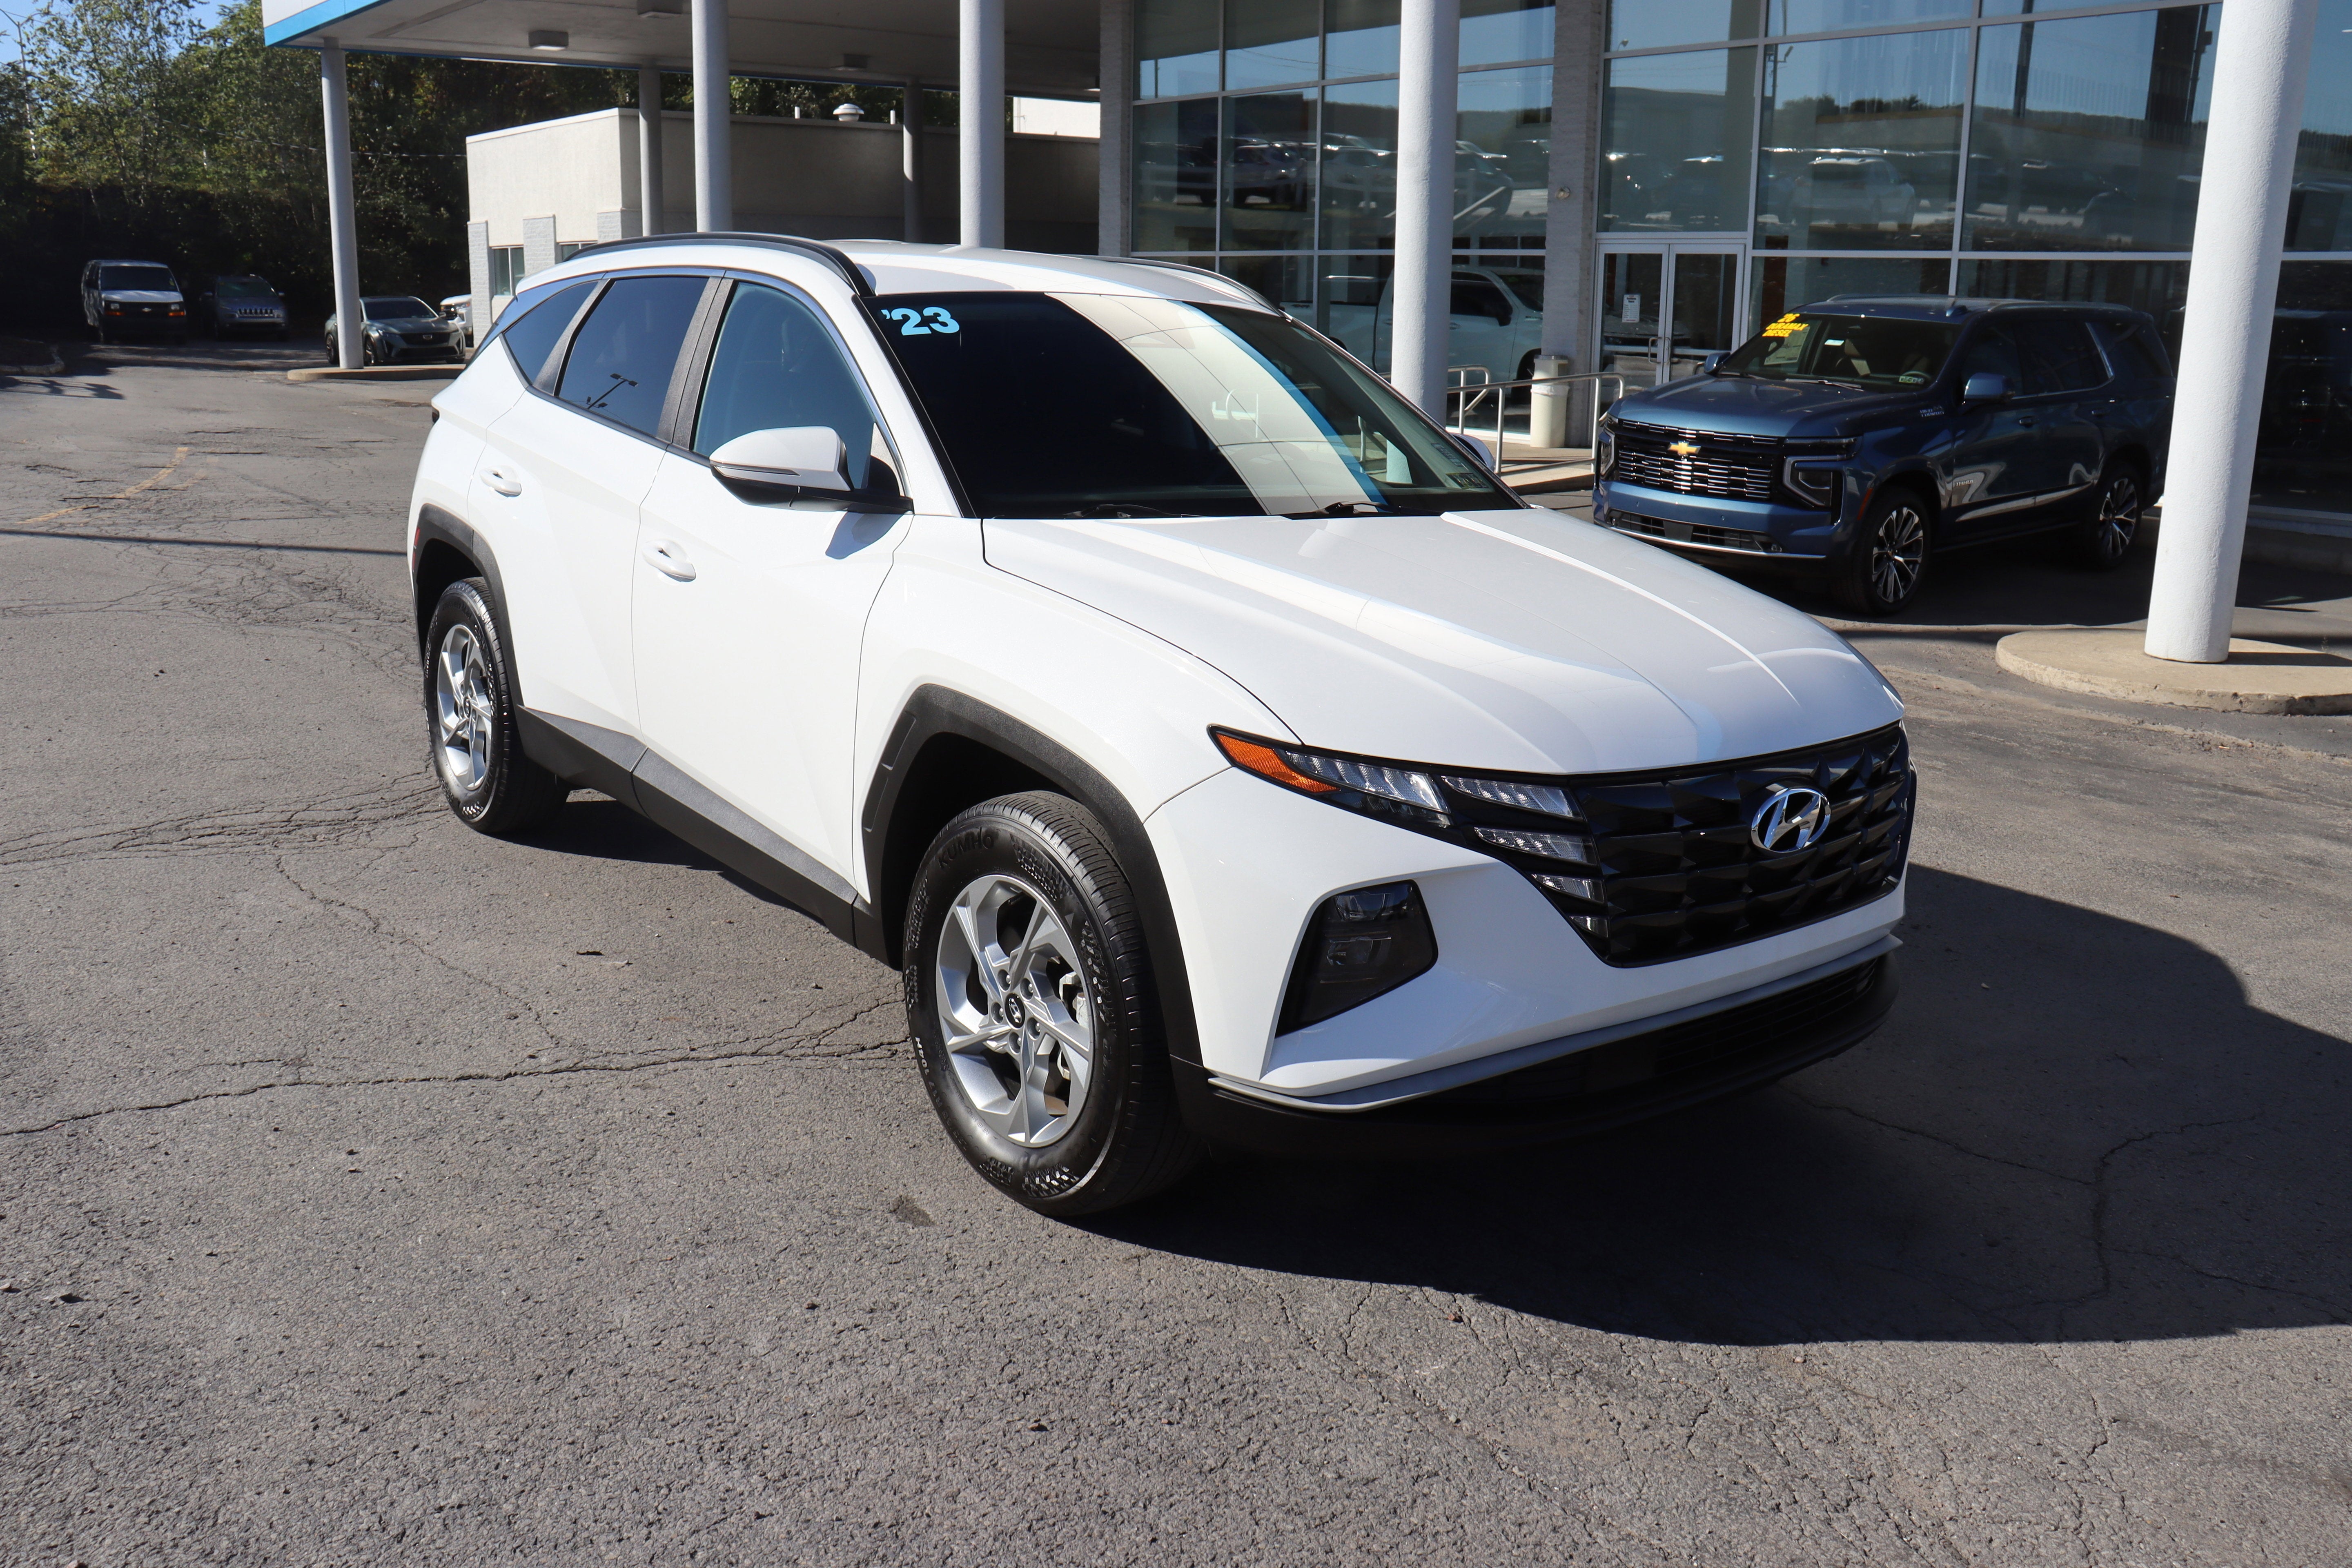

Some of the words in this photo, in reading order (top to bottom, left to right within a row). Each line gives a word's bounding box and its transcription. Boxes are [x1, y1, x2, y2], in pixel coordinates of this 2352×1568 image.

[881, 307, 960, 336] '23
[1765, 323, 1809, 331] DURAMAX
[937, 827, 996, 869] KUMHO
[915, 1037, 929, 1075] 104H
